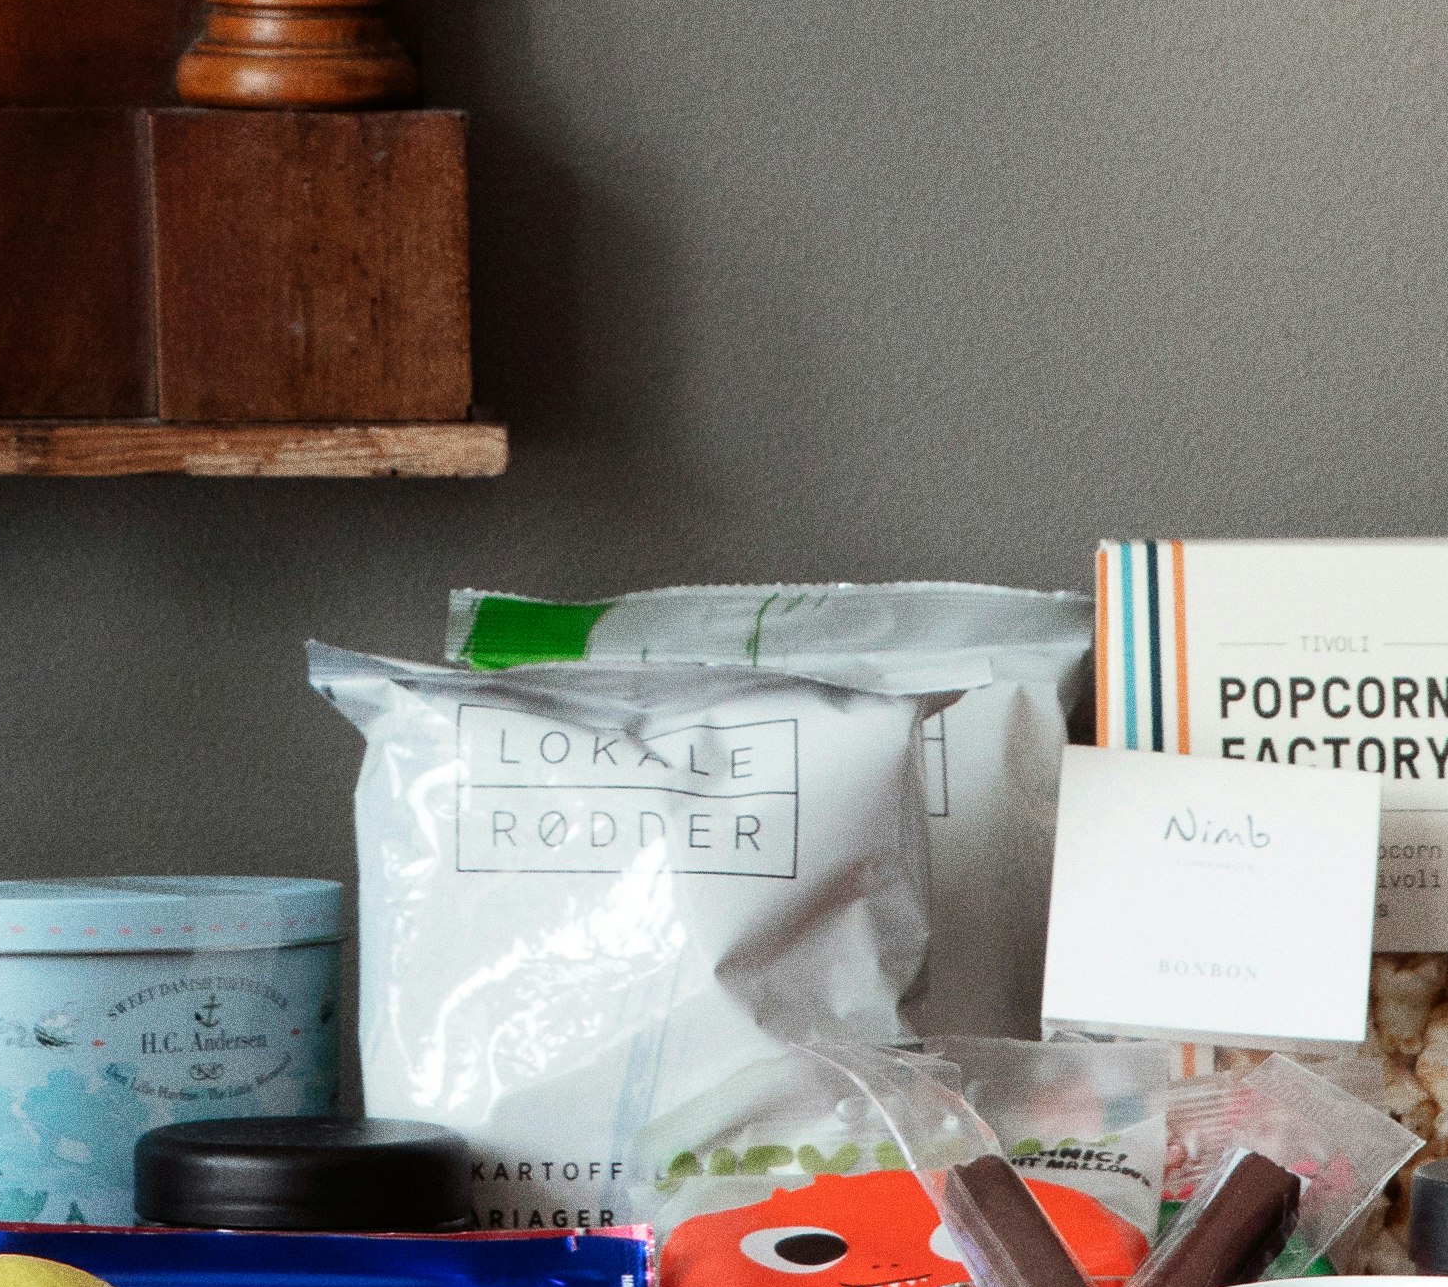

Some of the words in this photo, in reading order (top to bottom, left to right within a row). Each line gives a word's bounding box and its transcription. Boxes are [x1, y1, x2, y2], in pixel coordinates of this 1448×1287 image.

[1299, 635, 1371, 654] TIVOLI
[501, 729, 754, 779] LOKALE
[490, 810, 762, 851] RØDDER
[1164, 808, 1271, 849] Nimb
[1378, 869, 1441, 889] ivoli
[1157, 960, 1257, 980] BONBON
[108, 987, 155, 1021] SWEET
[141, 1032, 183, 1054] H.C.
[191, 1029, 268, 1052] Andersen
